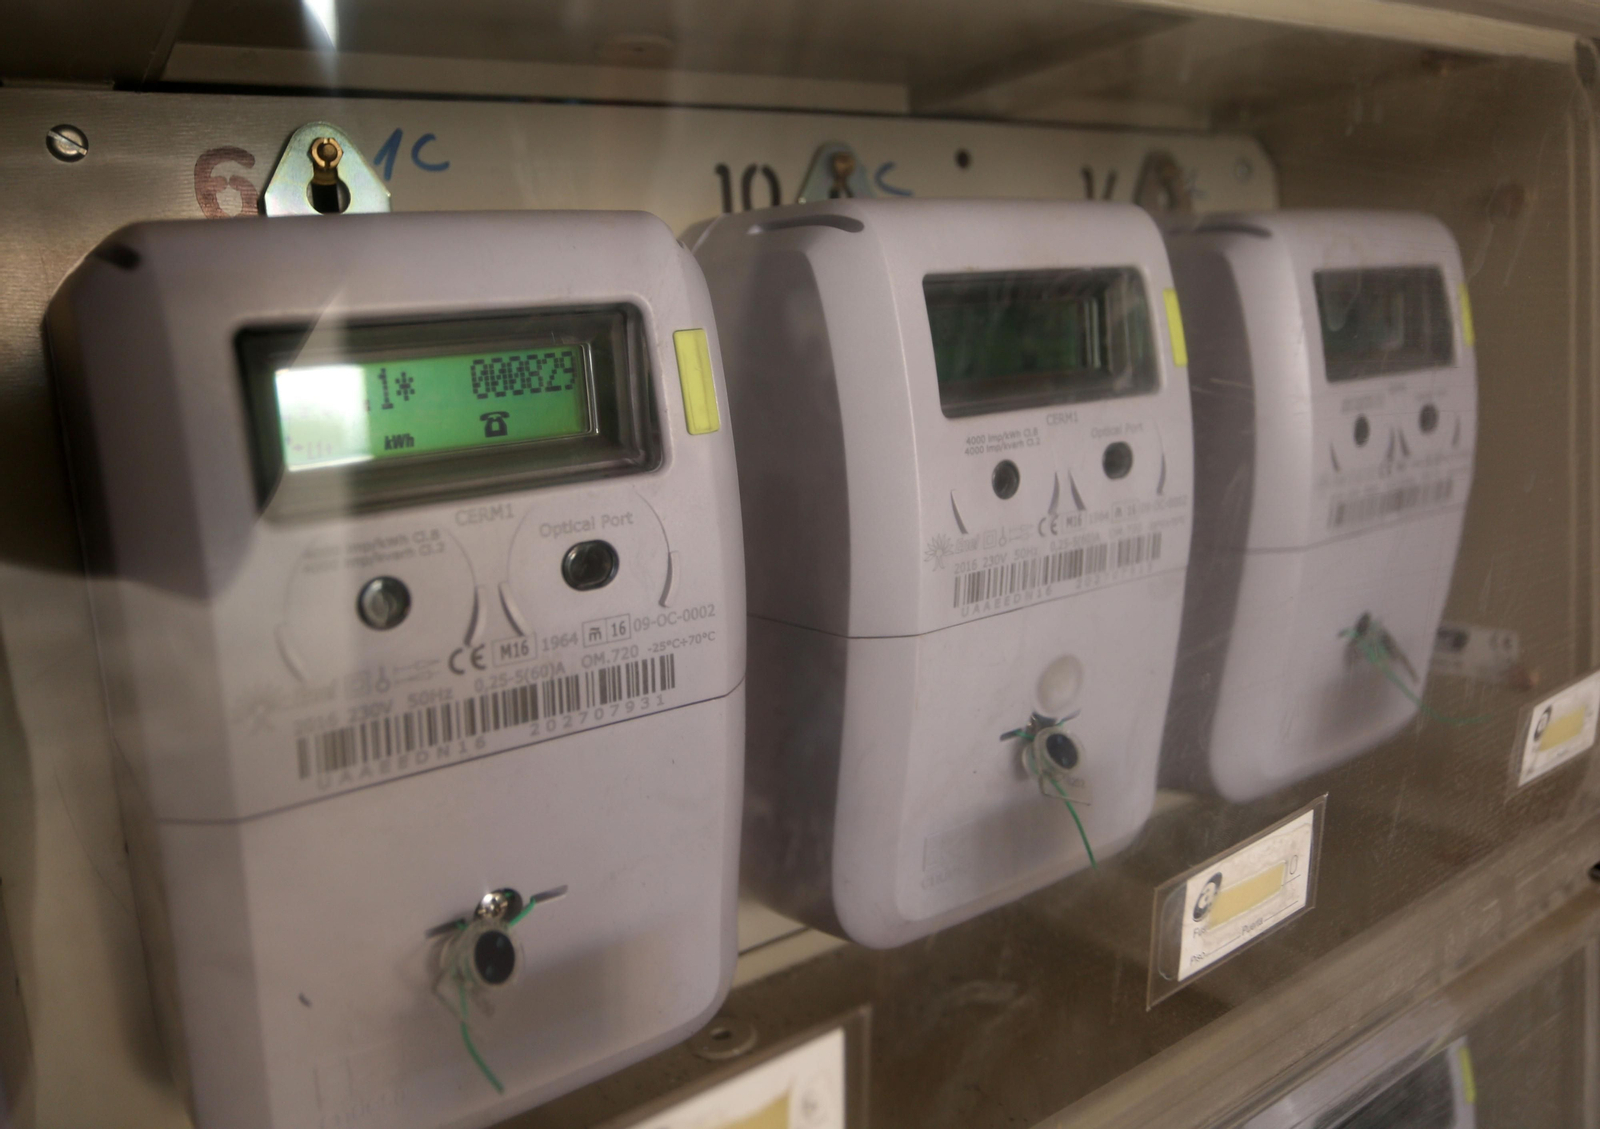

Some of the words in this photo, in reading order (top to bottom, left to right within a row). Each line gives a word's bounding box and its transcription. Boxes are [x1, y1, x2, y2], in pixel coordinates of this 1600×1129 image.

[194, 145, 261, 219] 6
[384, 433, 415, 451] kWh
[454, 503, 515, 527] CERM1
[538, 516, 597, 539] Optical
[601, 510, 635, 530] Port
[499, 641, 530, 662] M16
[541, 632, 580, 652] 1964
[633, 604, 716, 633] 09-OC-0002
